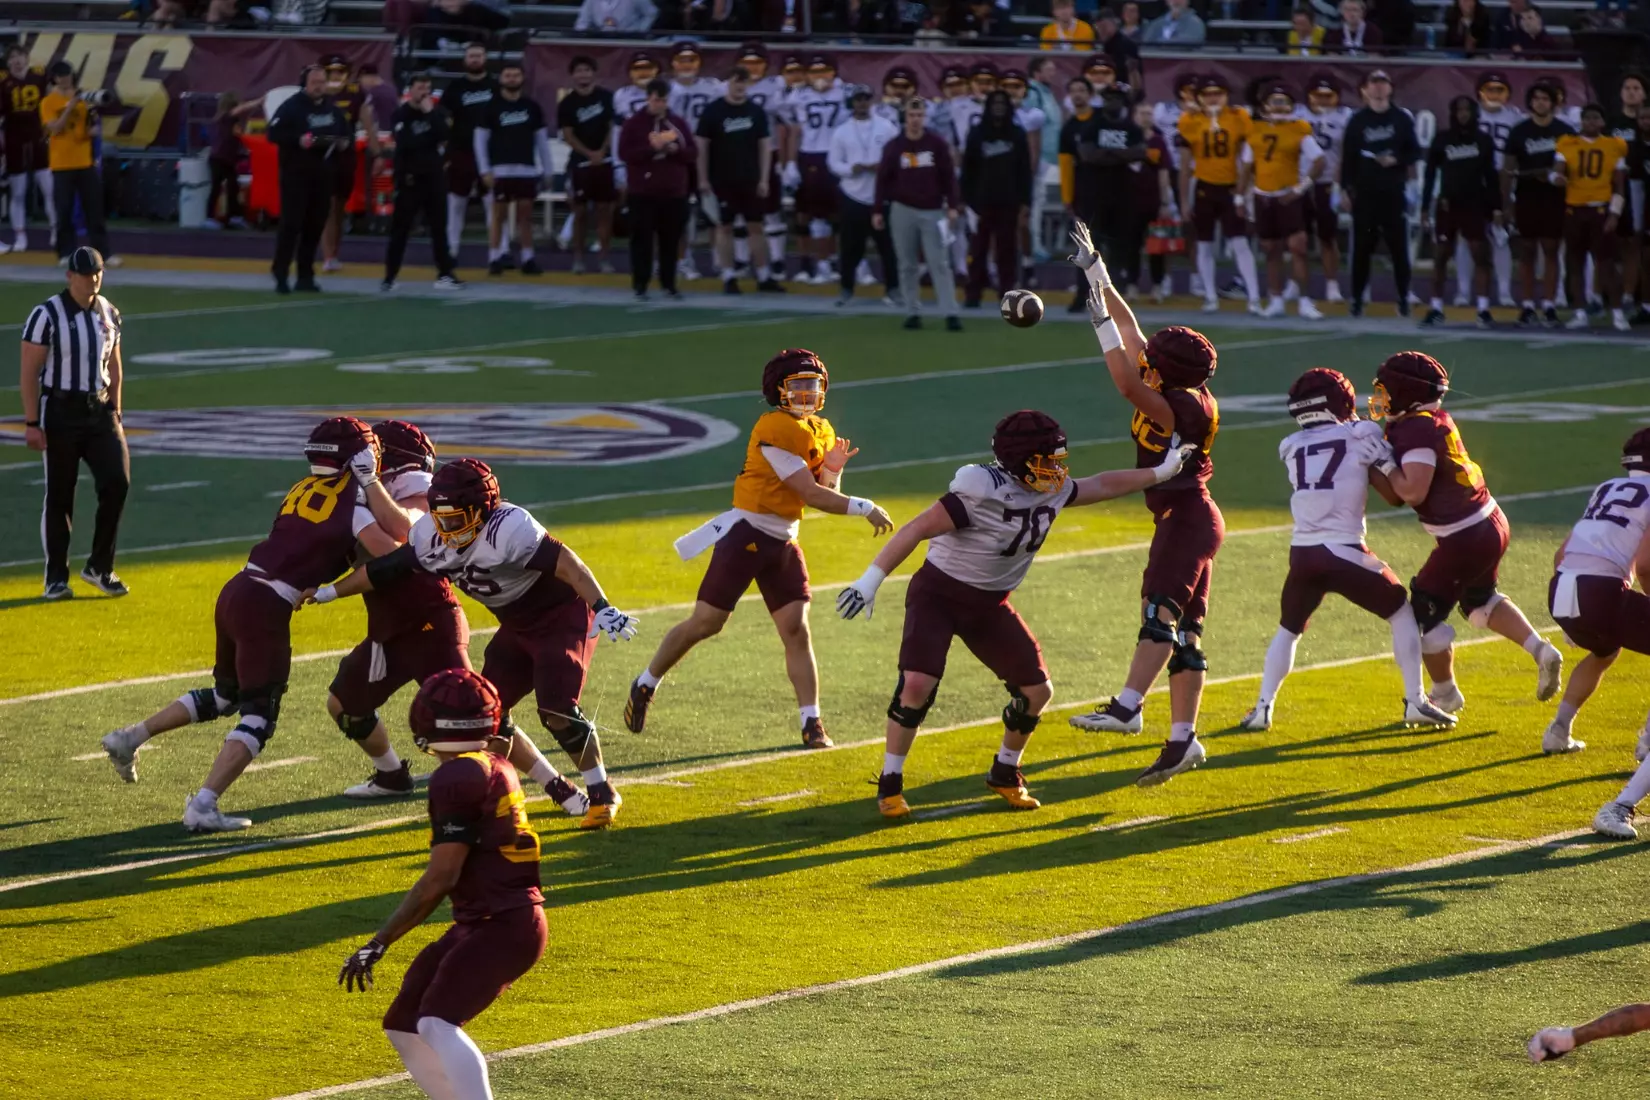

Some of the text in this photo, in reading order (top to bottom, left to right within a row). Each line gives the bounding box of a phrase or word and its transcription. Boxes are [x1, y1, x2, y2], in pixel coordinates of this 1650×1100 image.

[806, 101, 840, 130] 67
[1202, 129, 1230, 159] 18
[1262, 134, 1279, 163] 7
[1577, 148, 1605, 179] 10
[1294, 439, 1346, 490] 17
[1582, 482, 1650, 528] 12
[999, 505, 1056, 557] 70
